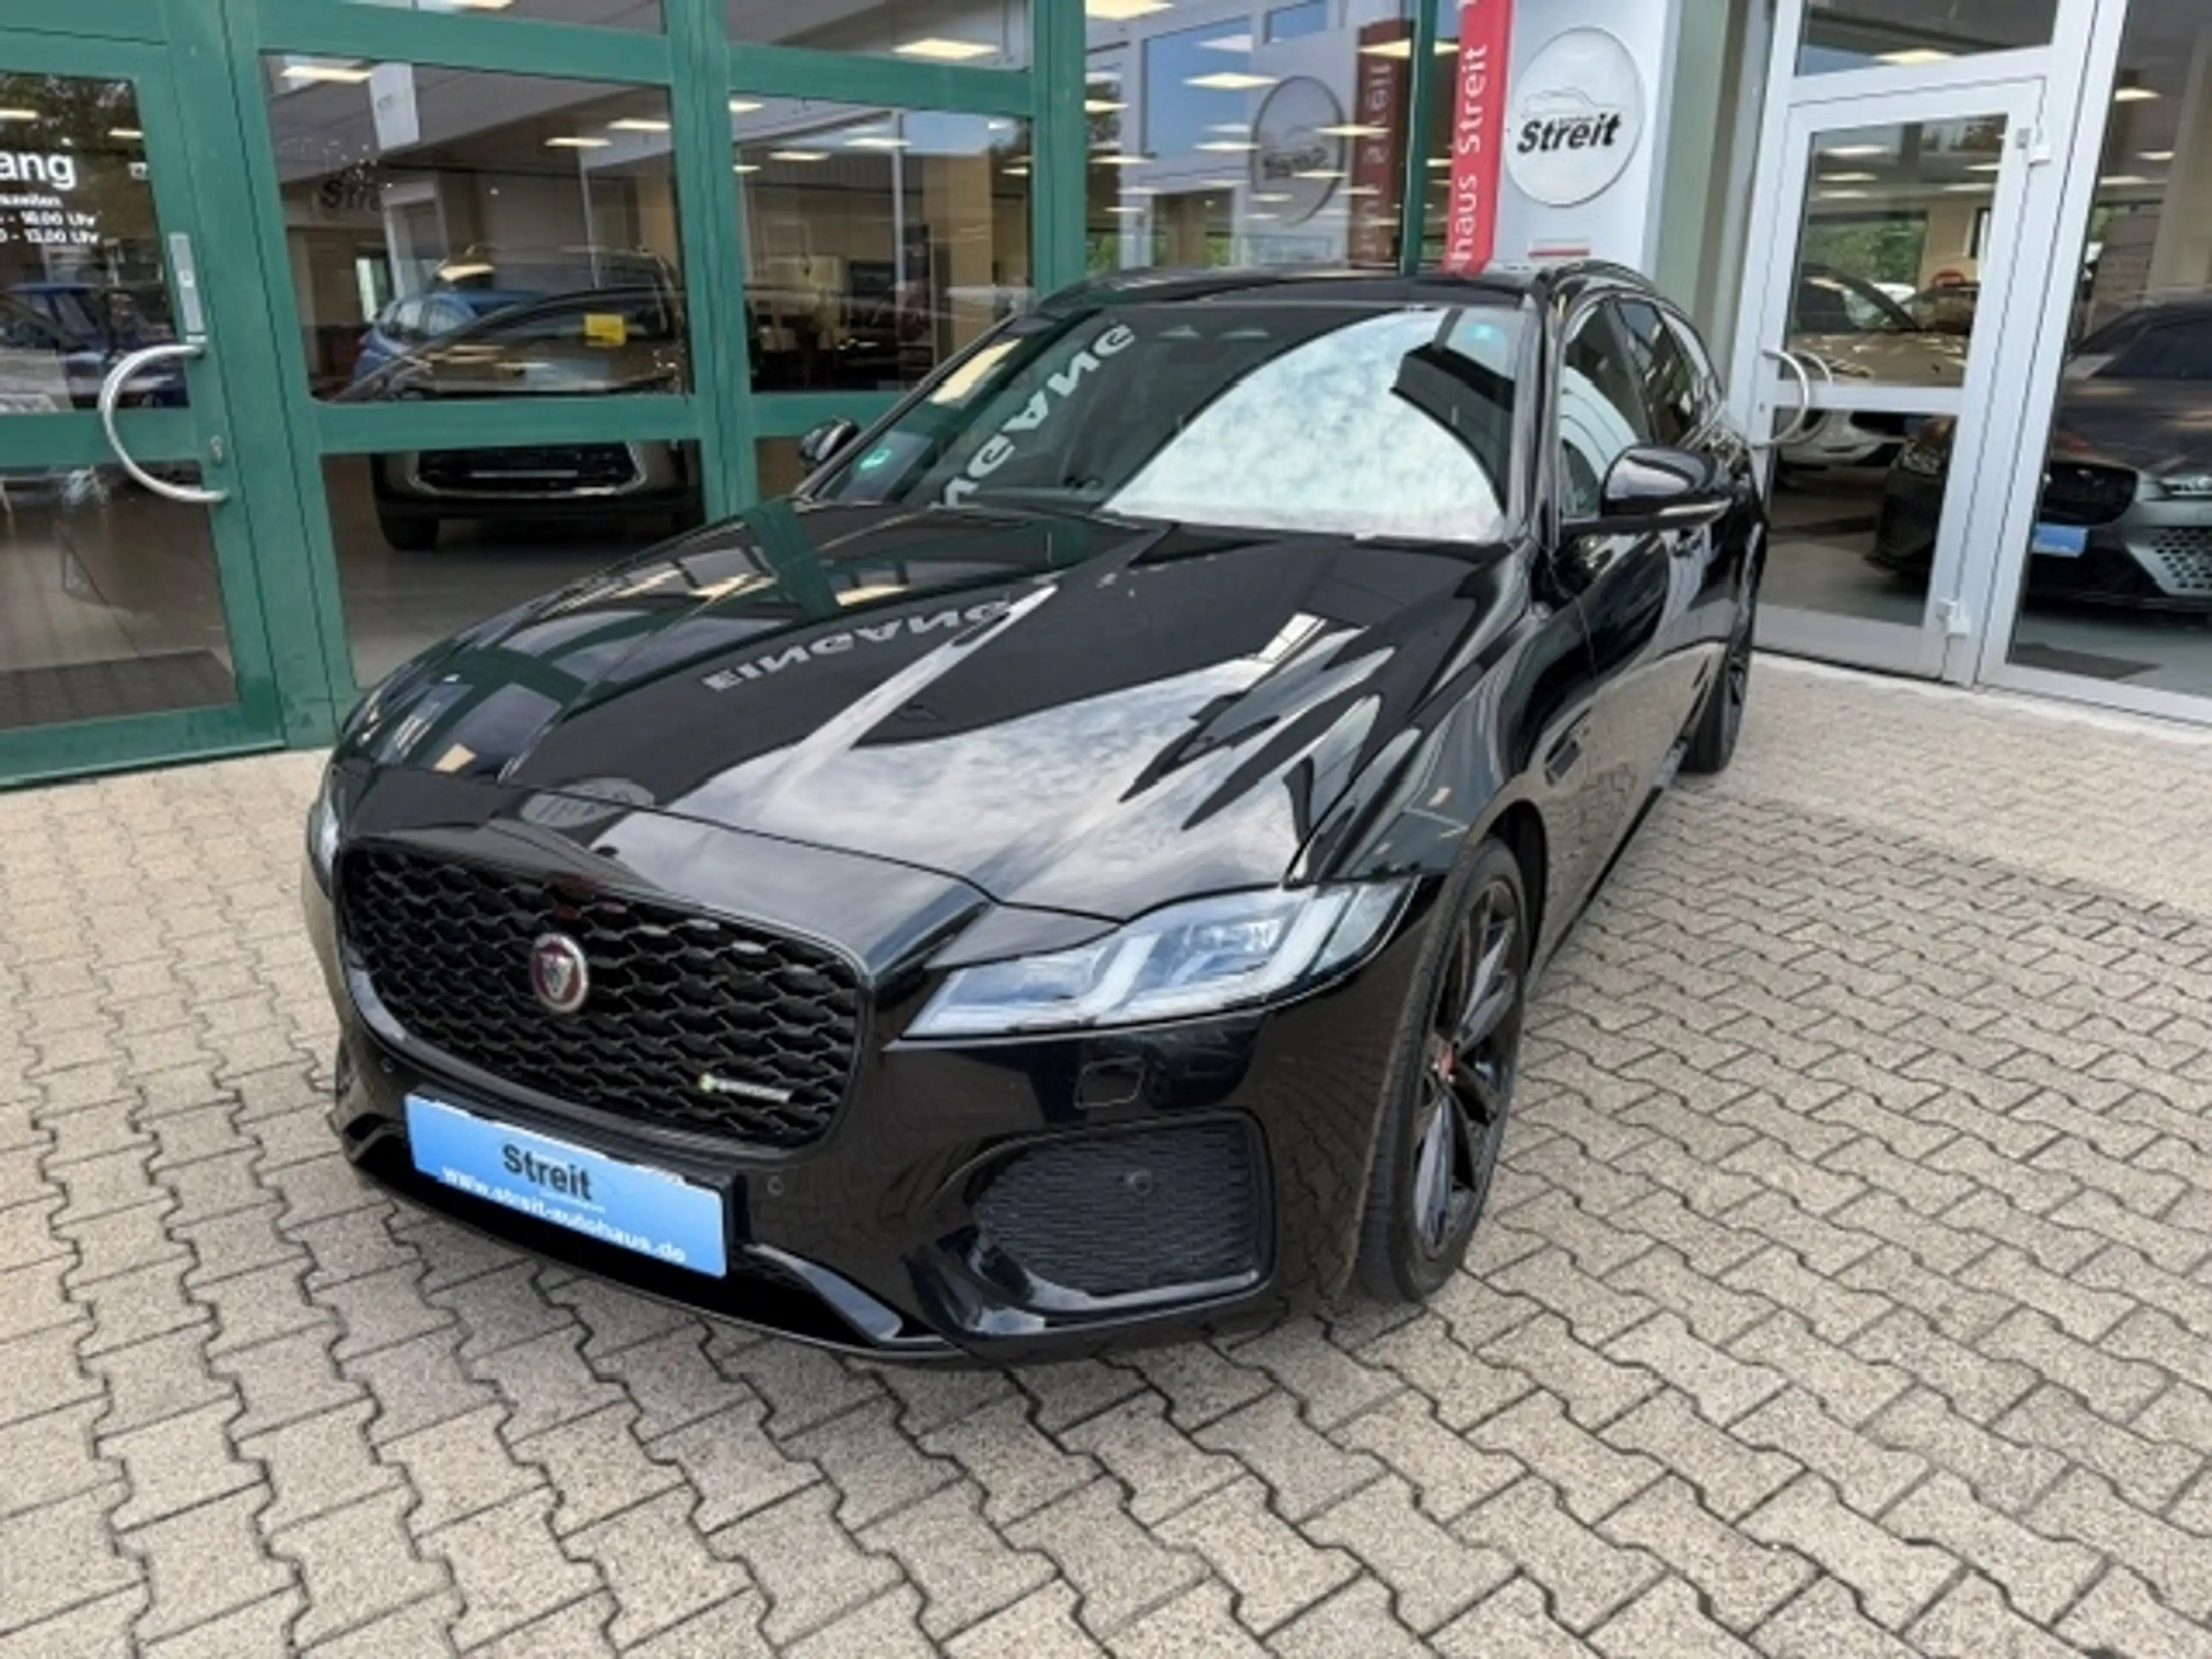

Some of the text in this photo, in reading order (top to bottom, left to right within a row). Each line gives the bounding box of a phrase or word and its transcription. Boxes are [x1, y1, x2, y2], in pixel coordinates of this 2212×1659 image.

[1457, 44, 1487, 155] Streit
[1517, 113, 1622, 154] Streit
[0, 151, 77, 191] ang
[501, 1143, 593, 1200] Streit
[441, 1166, 687, 1263] www.streit-autohaus.de
